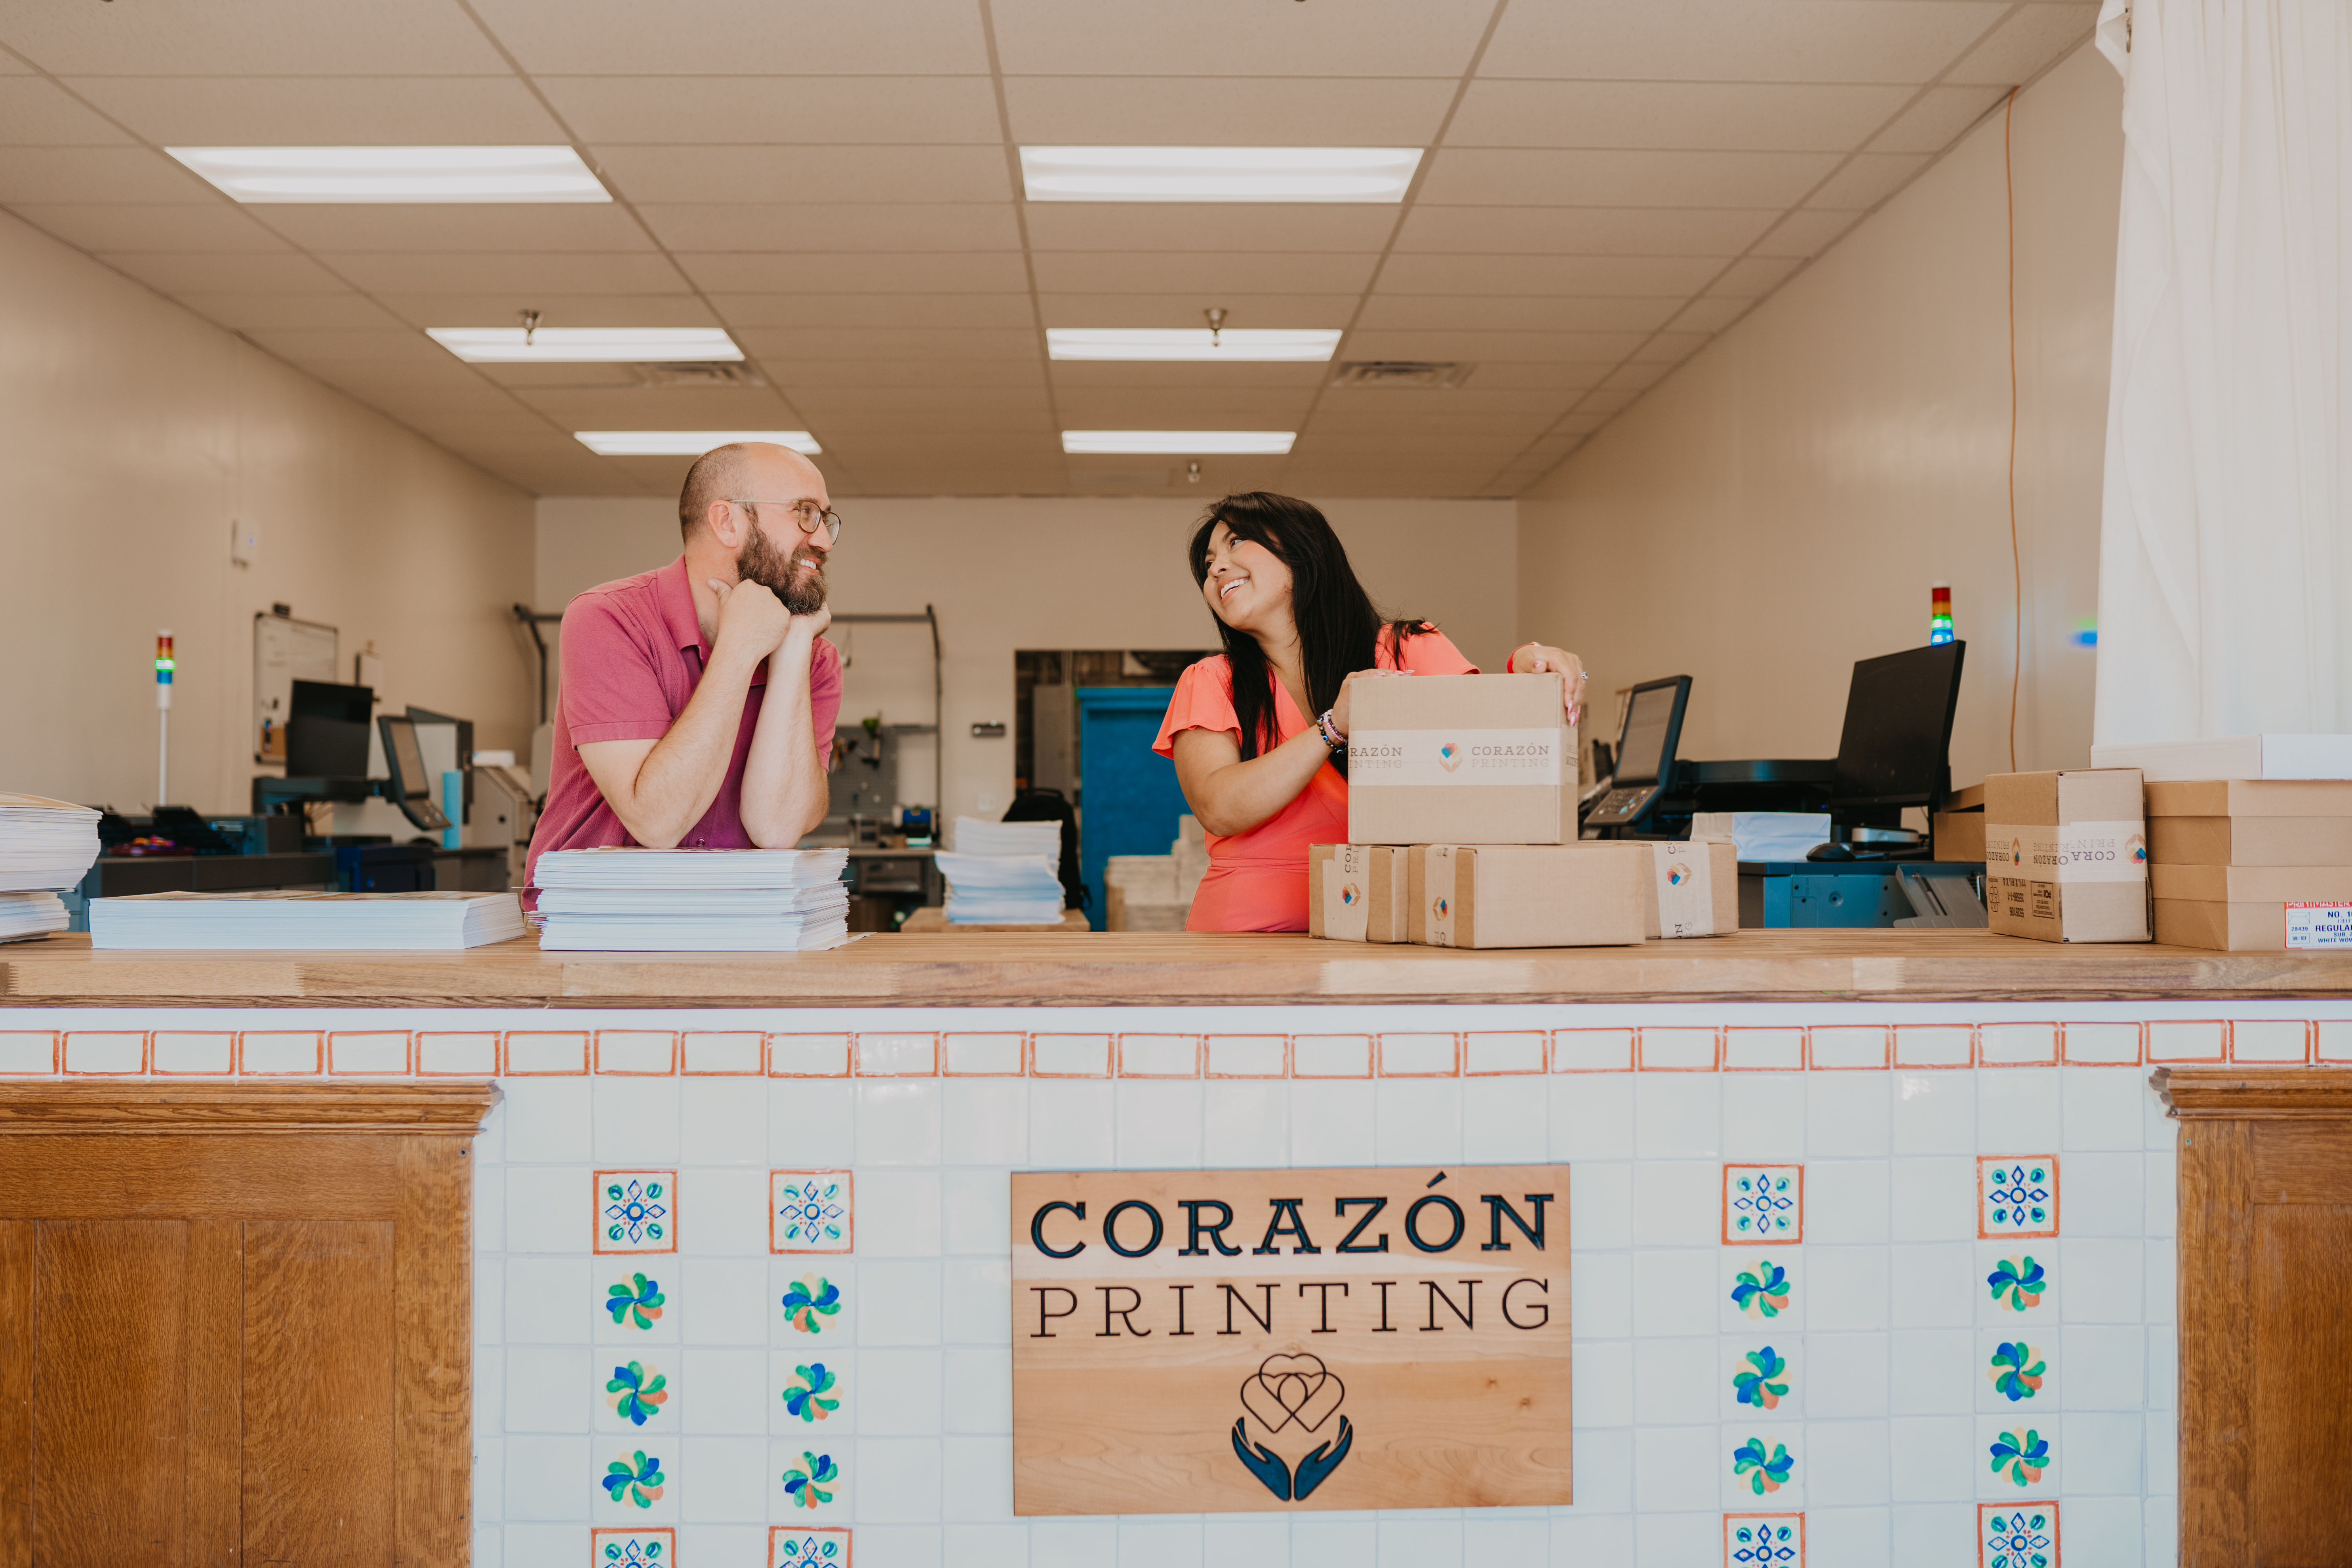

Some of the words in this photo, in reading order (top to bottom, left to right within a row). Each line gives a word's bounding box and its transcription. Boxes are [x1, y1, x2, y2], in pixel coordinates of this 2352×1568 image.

[1471, 758, 1549, 768] PRINTING
[1472, 743, 1550, 756] CORAZÓN
[1030, 1170, 1555, 1259] CORAZÓN
[1029, 1277, 1549, 1338] PRINTING
